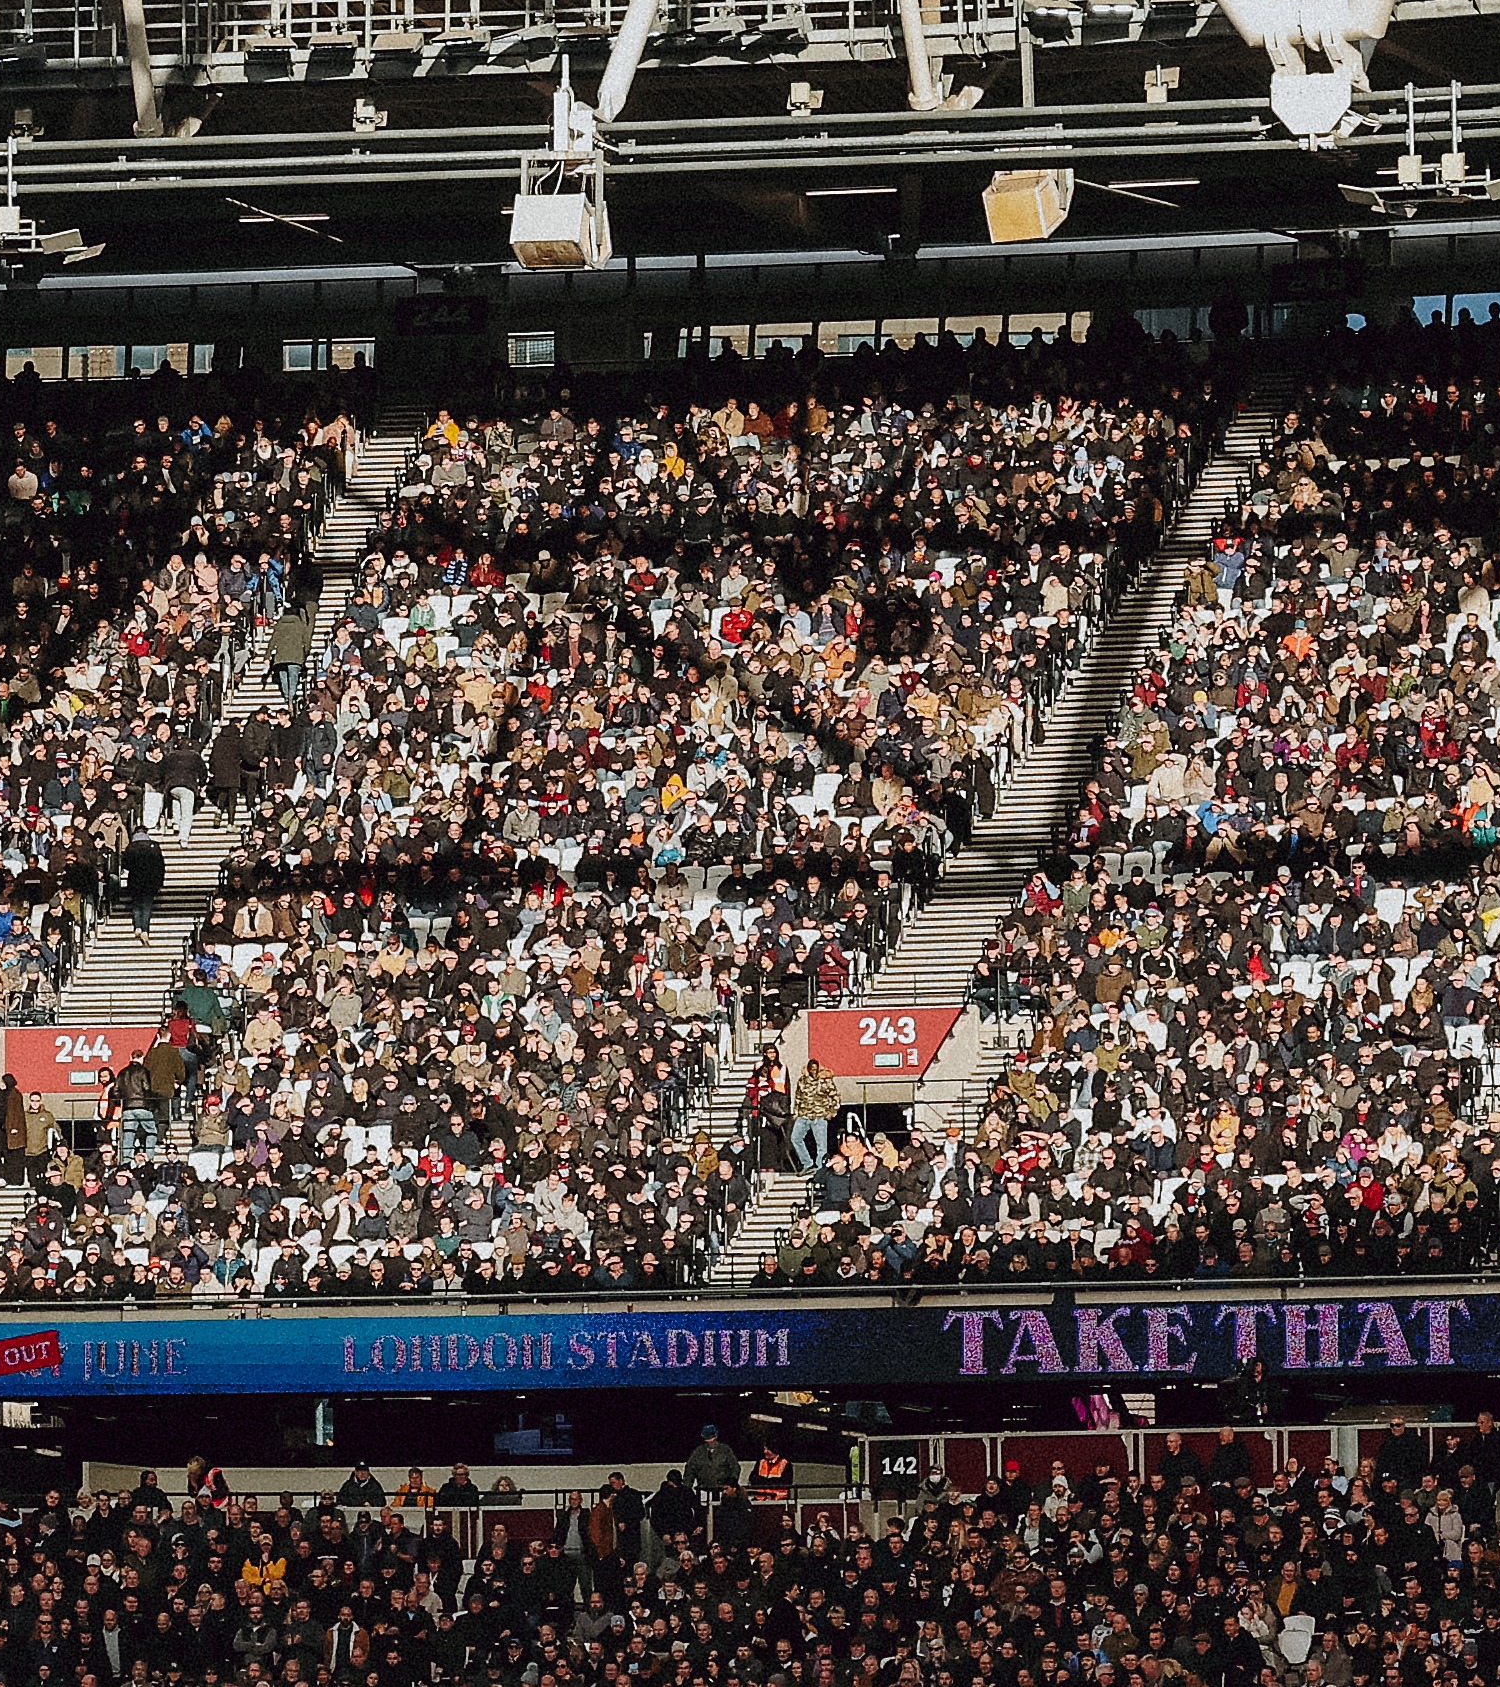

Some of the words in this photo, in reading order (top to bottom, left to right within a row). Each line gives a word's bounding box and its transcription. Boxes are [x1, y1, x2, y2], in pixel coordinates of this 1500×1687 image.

[859, 1017, 916, 1045] 243
[55, 1035, 112, 1062] 244
[342, 1333, 553, 1374] LONDON
[567, 1328, 791, 1371] STADIUM
[942, 1304, 1198, 1375] TAKE
[1214, 1299, 1471, 1369] THAT
[3, 1341, 51, 1366] OUT
[83, 1337, 188, 1380] JUNE
[882, 1456, 918, 1475] 142
